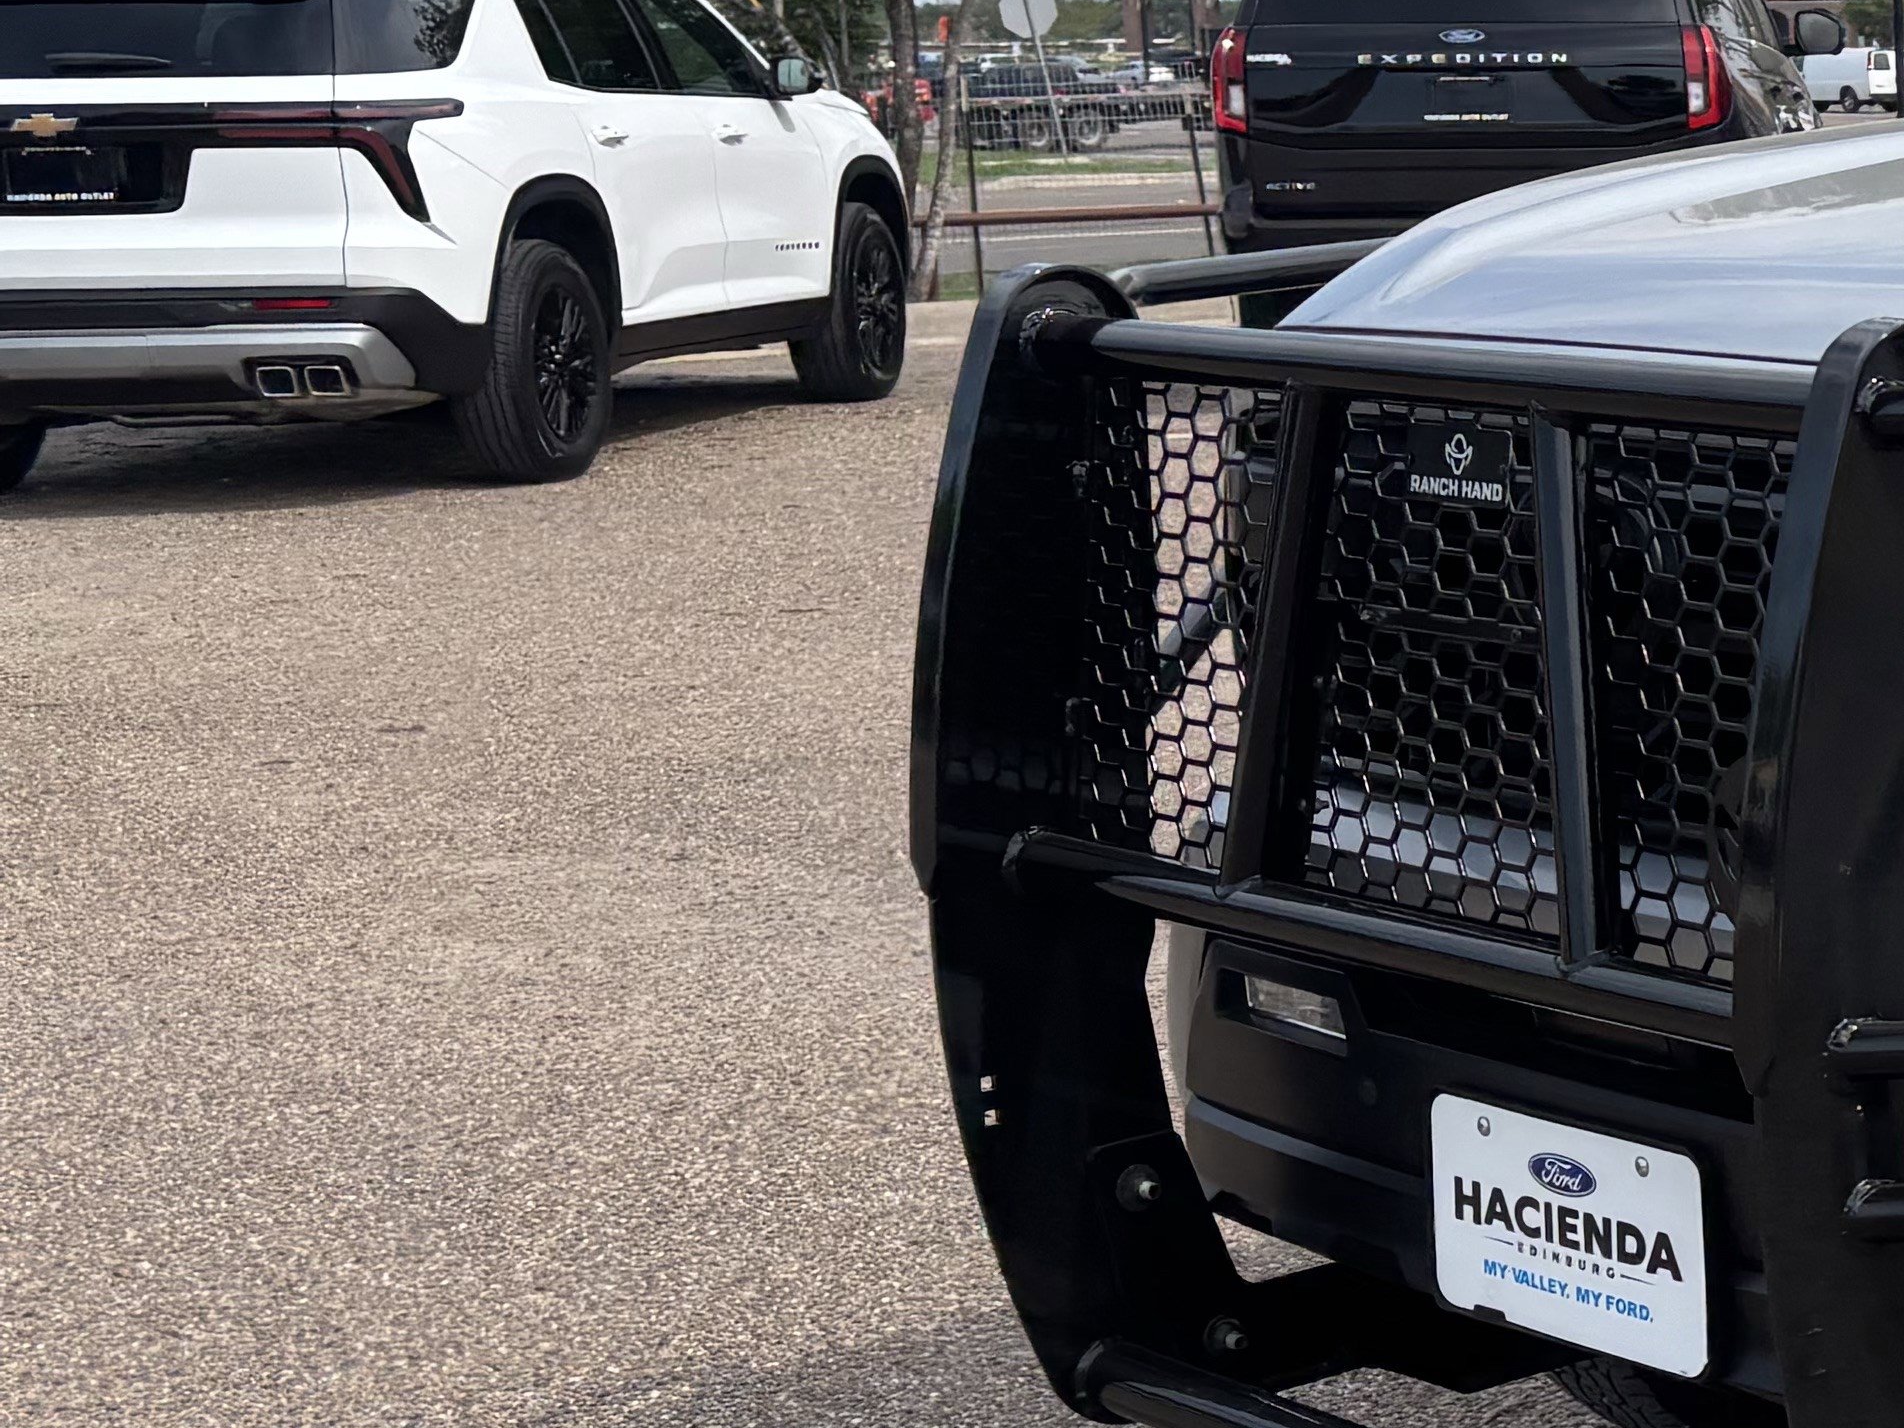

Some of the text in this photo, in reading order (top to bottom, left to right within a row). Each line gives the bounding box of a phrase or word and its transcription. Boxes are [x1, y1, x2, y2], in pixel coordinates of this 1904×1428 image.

[1357, 52, 1568, 65] EXPEDITION
[1409, 473, 1504, 503] RANCH HAND
[1541, 1156, 1584, 1193] Ford
[1454, 1175, 1684, 1283] HACIENDA
[1517, 1240, 1617, 1280] EDINBURG
[1483, 1258, 1655, 1323] MY VALLEY. MY FORD.
